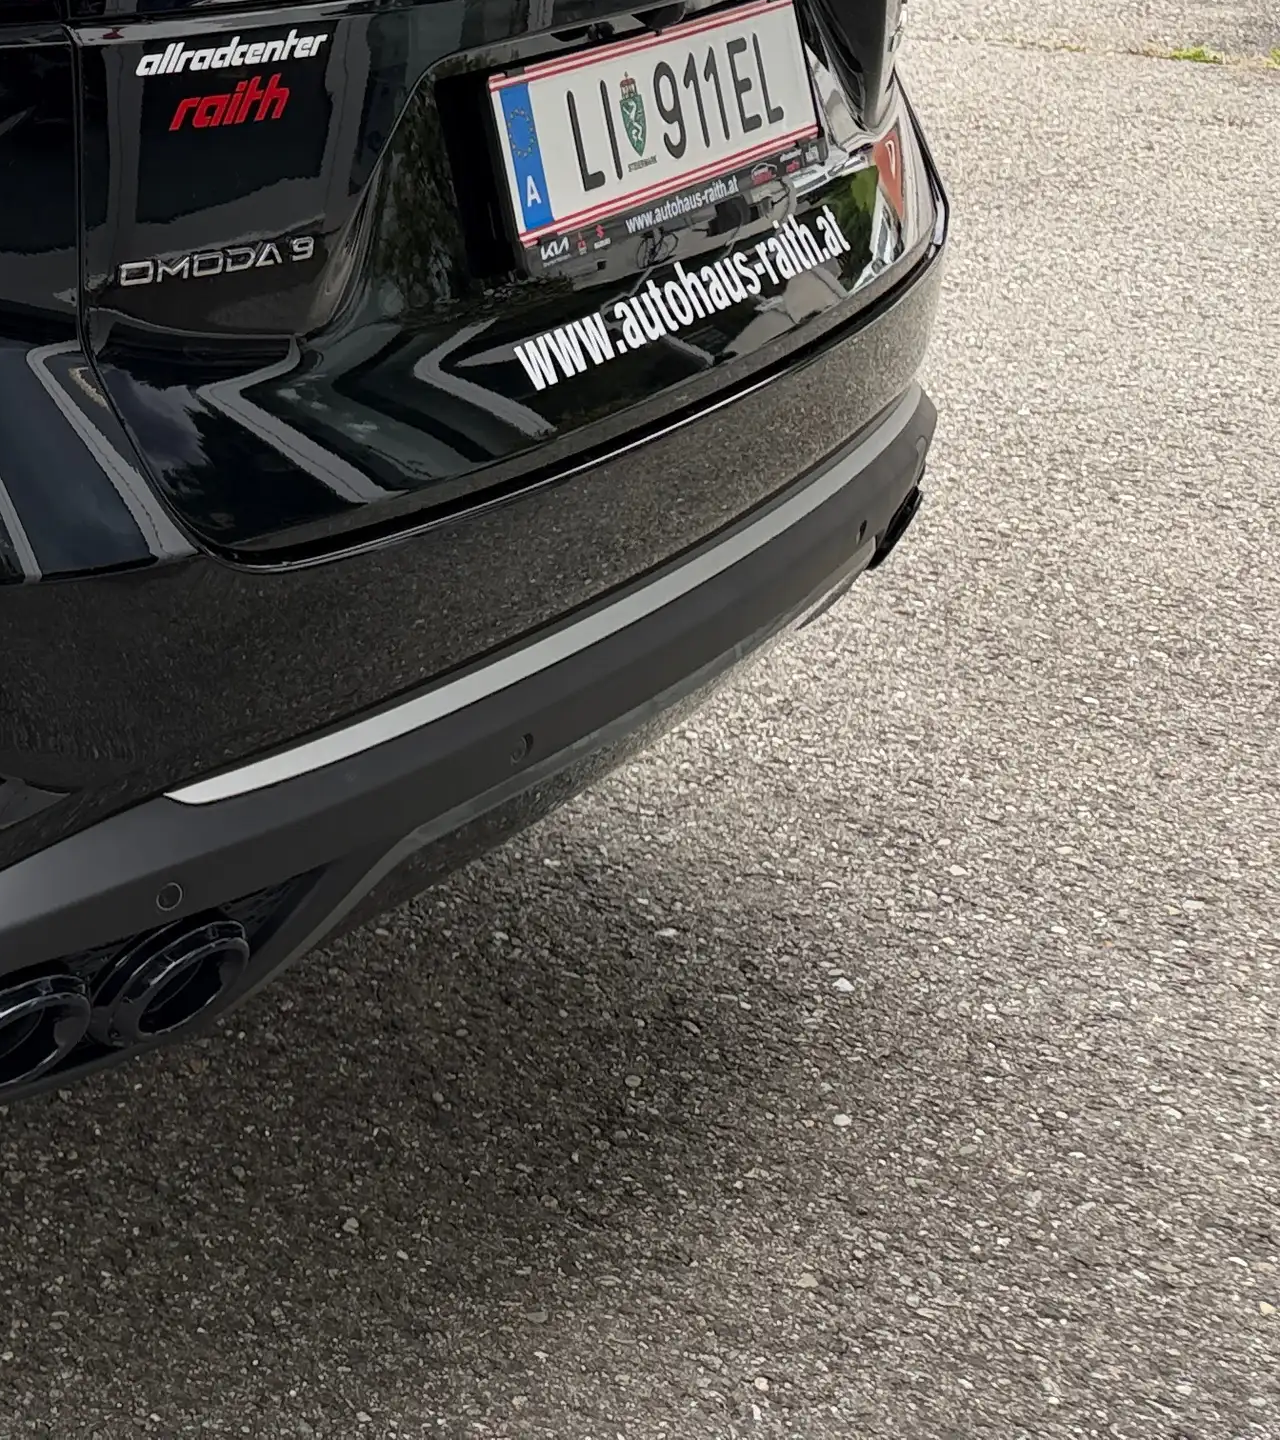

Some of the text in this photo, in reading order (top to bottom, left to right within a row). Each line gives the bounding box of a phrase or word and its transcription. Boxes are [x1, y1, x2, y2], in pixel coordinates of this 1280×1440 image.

[134, 28, 330, 78] allradcenter
[167, 72, 291, 132] raith
[565, 32, 785, 193] LI 911EL
[526, 174, 542, 208] A
[624, 174, 740, 234] www.autohaus-raith.at
[119, 235, 317, 288] OMODA 9
[513, 203, 852, 392] www.autohaus-raith.at
